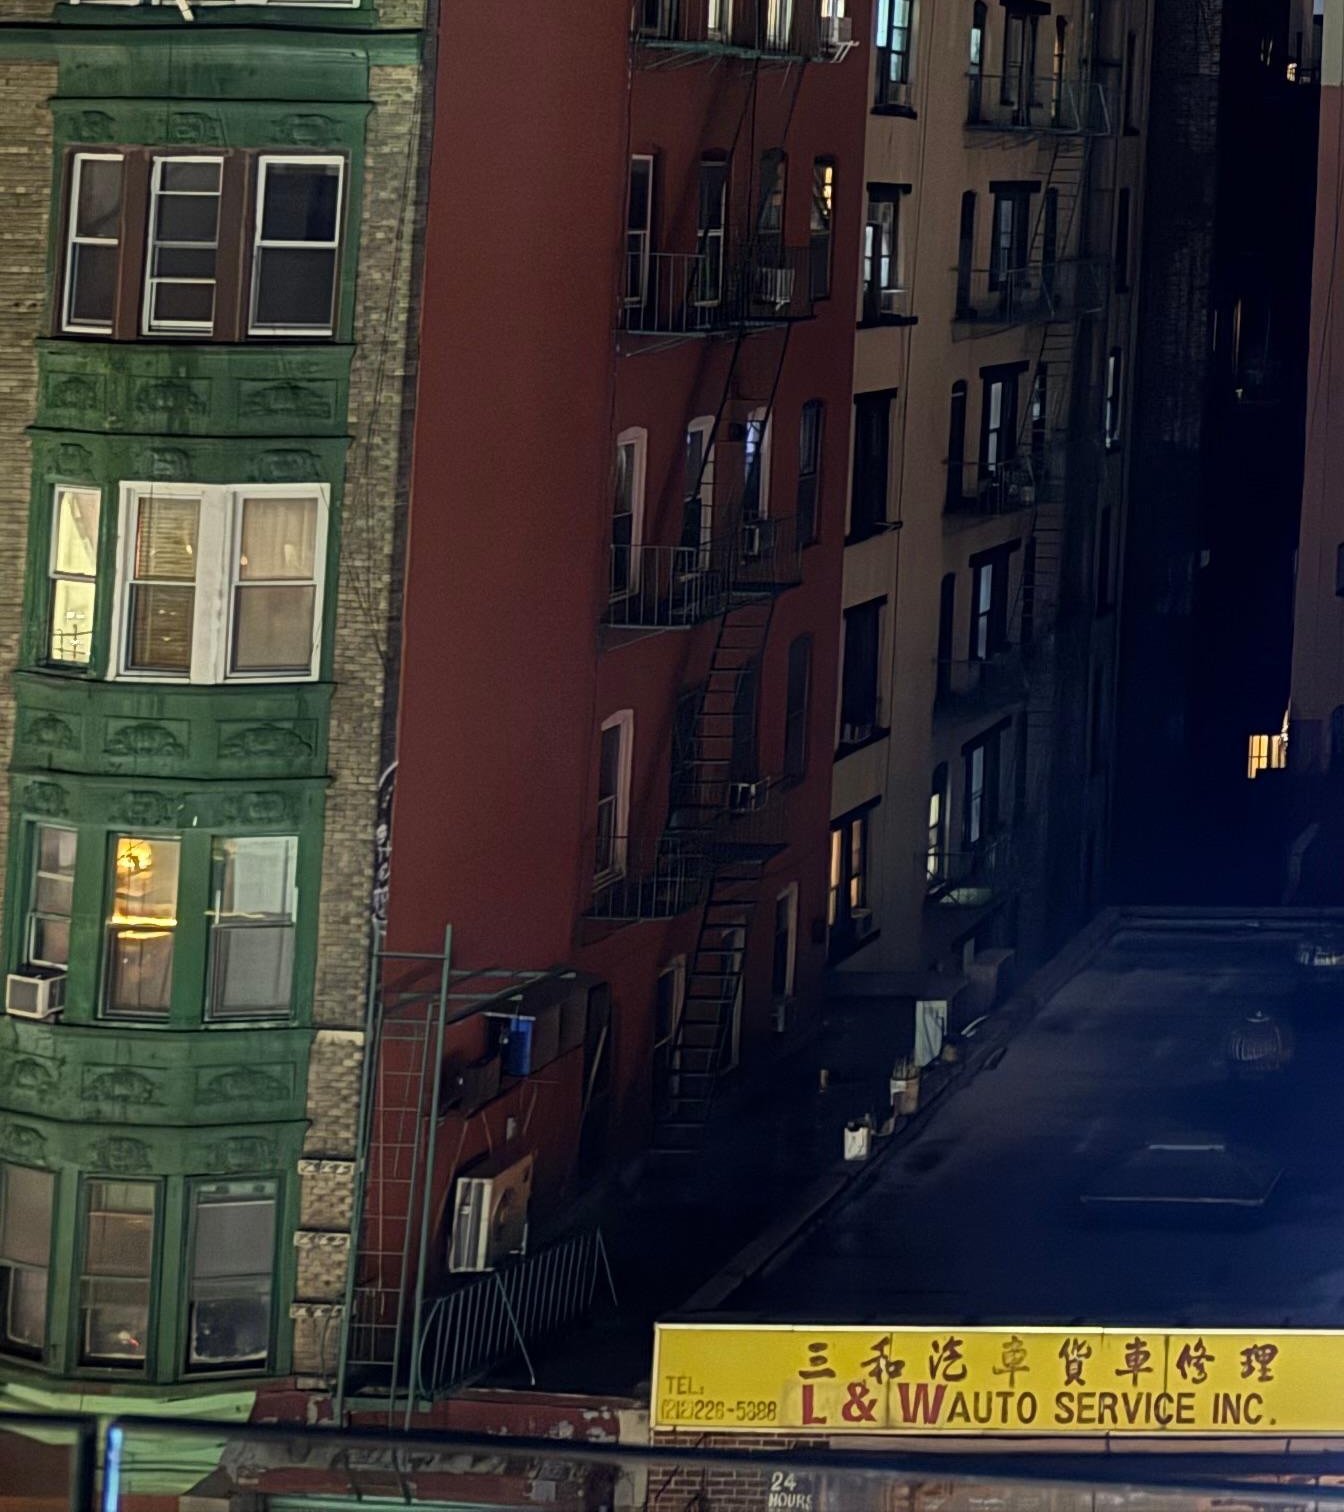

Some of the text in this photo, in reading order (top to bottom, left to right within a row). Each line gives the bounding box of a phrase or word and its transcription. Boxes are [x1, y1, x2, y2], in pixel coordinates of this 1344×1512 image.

[802, 1383, 828, 1425] L
[841, 1381, 878, 1424] &
[1054, 1391, 1196, 1425] SERVICE
[1212, 1392, 1277, 1426] INC.
[771, 1471, 798, 1492] 24
